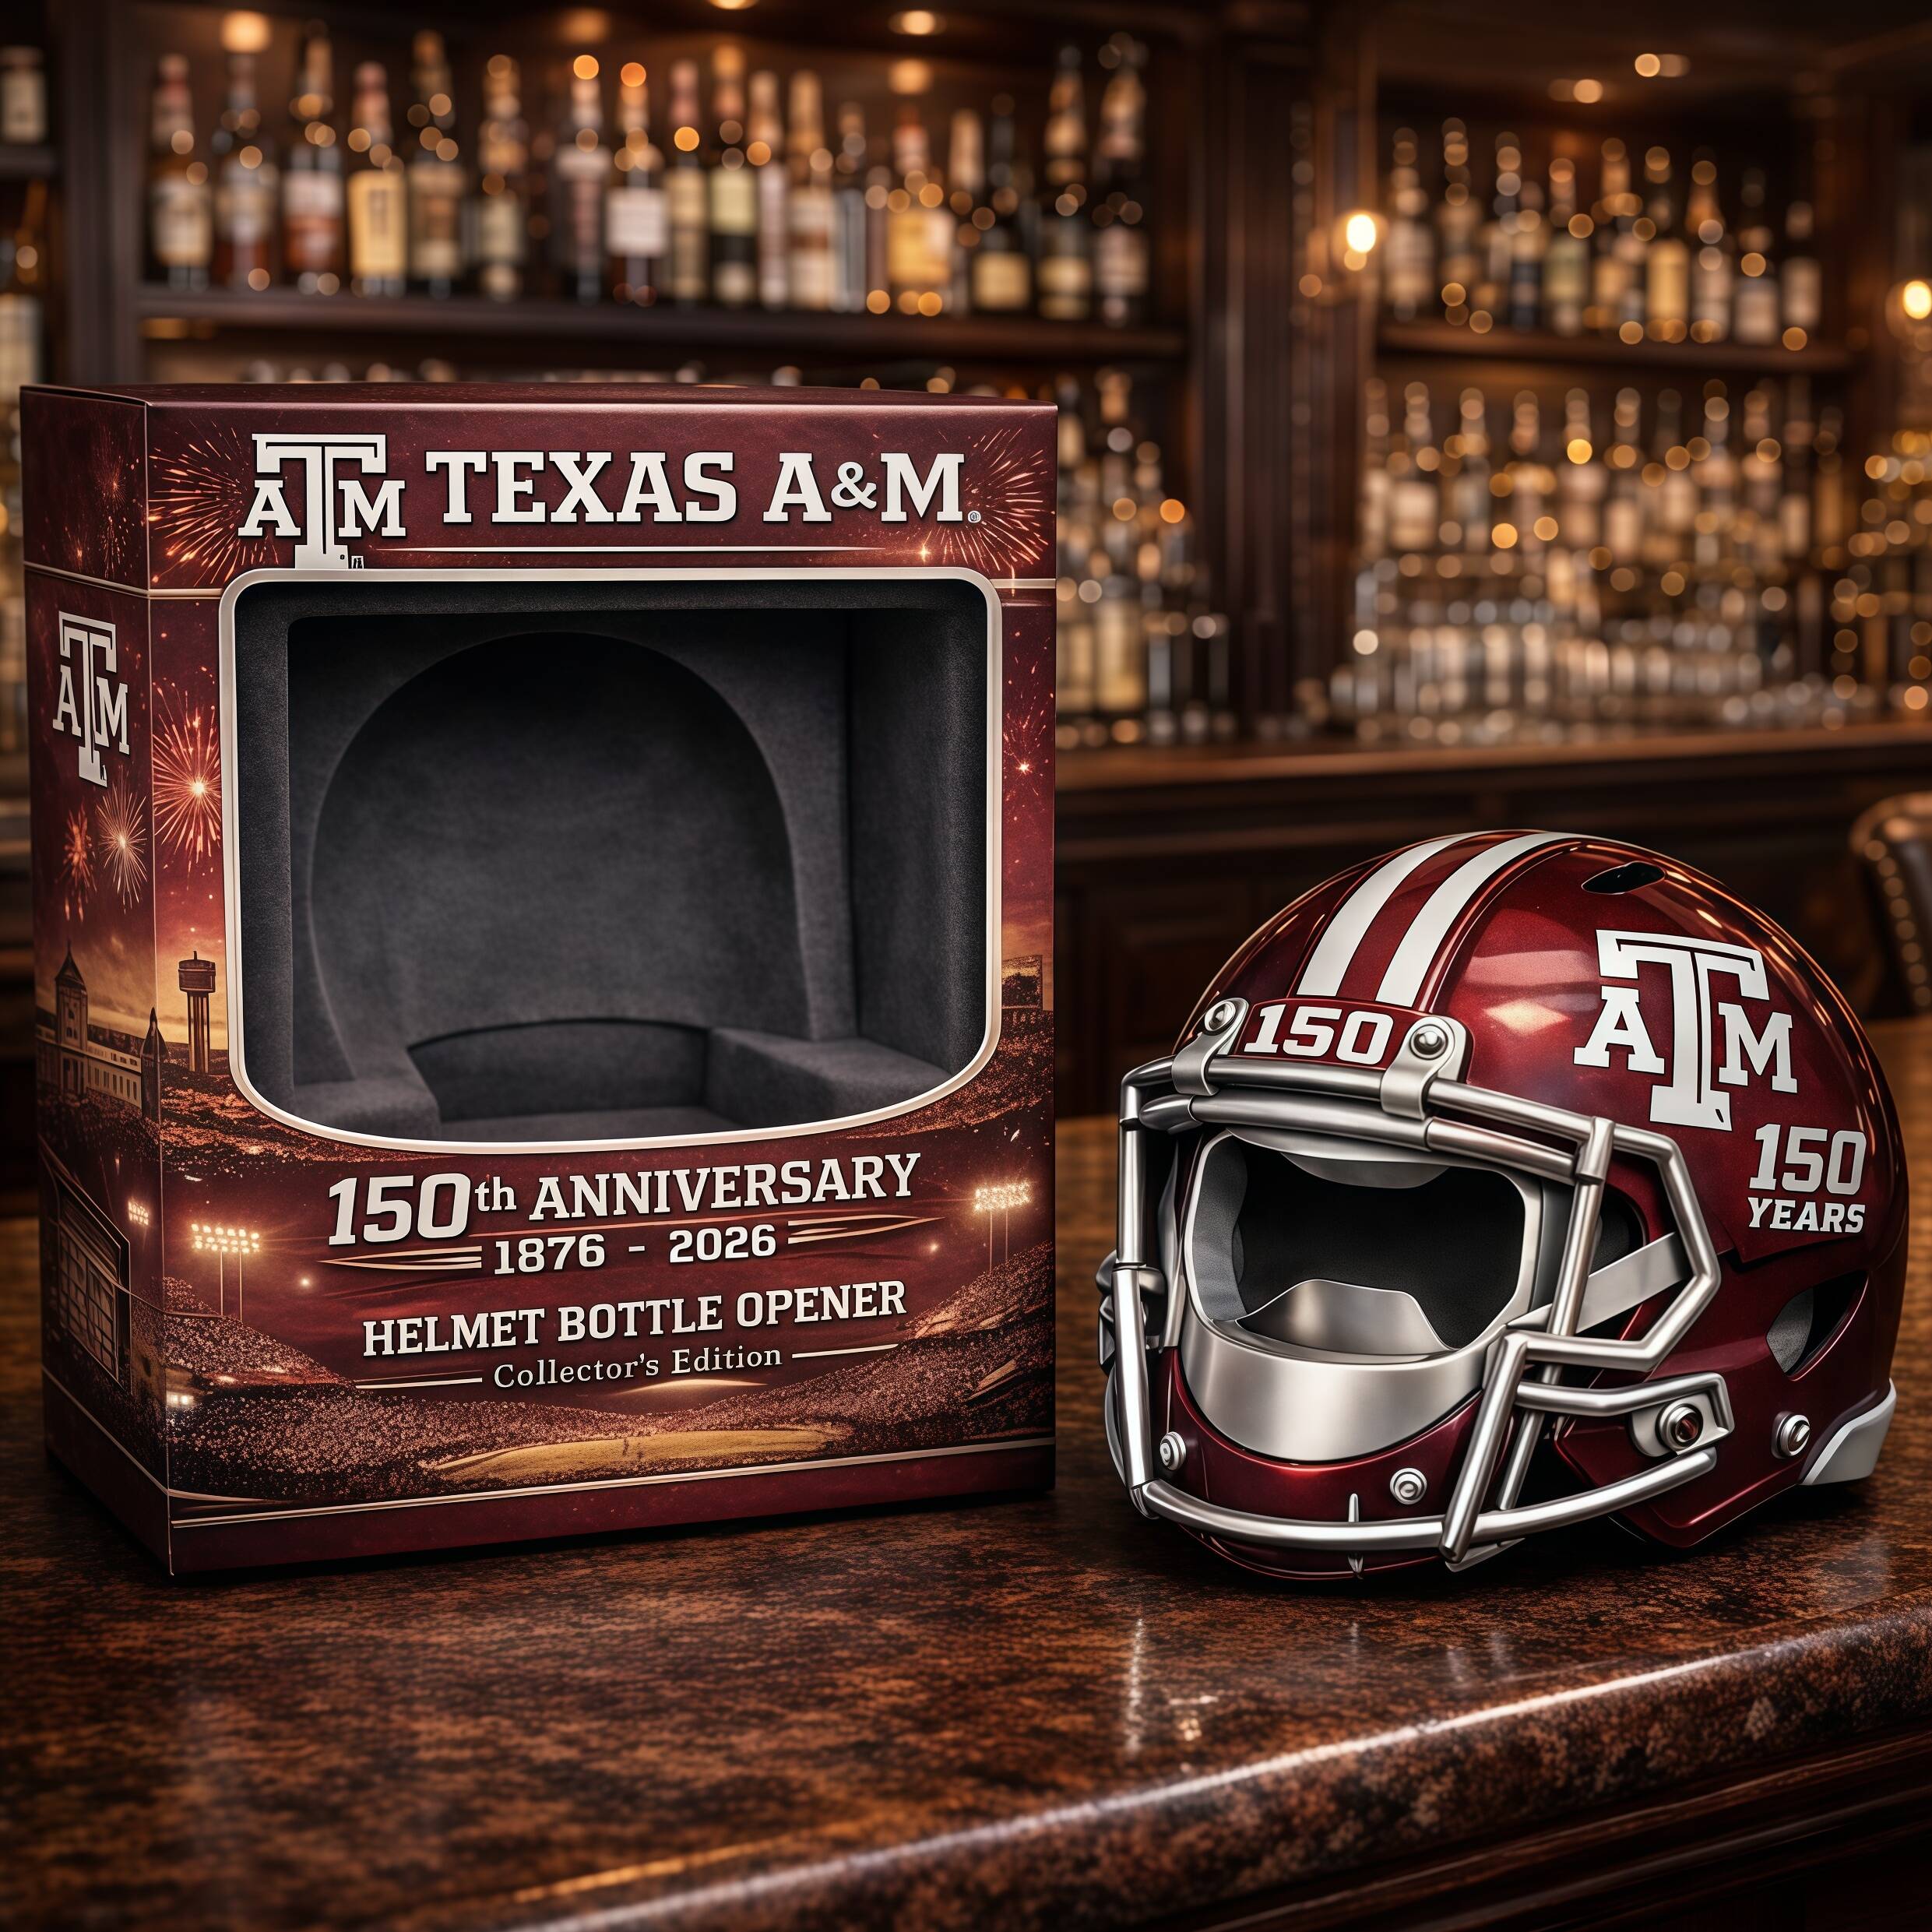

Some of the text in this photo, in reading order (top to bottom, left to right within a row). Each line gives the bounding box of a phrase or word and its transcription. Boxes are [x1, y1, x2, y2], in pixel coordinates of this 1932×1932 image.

[425, 451, 737, 523] TEXAS
[1244, 1003, 1395, 1065] 150
[1748, 1123, 1867, 1196] 150
[327, 1153, 921, 1246] 150th ANNIVERSARY
[1747, 1197, 1867, 1234] YEARS
[494, 1233, 606, 1276] 1876
[668, 1223, 778, 1265] 2026
[363, 1279, 907, 1357] HELMET BOTTLE OPENER
[493, 1343, 783, 1390] Collector's Edition
